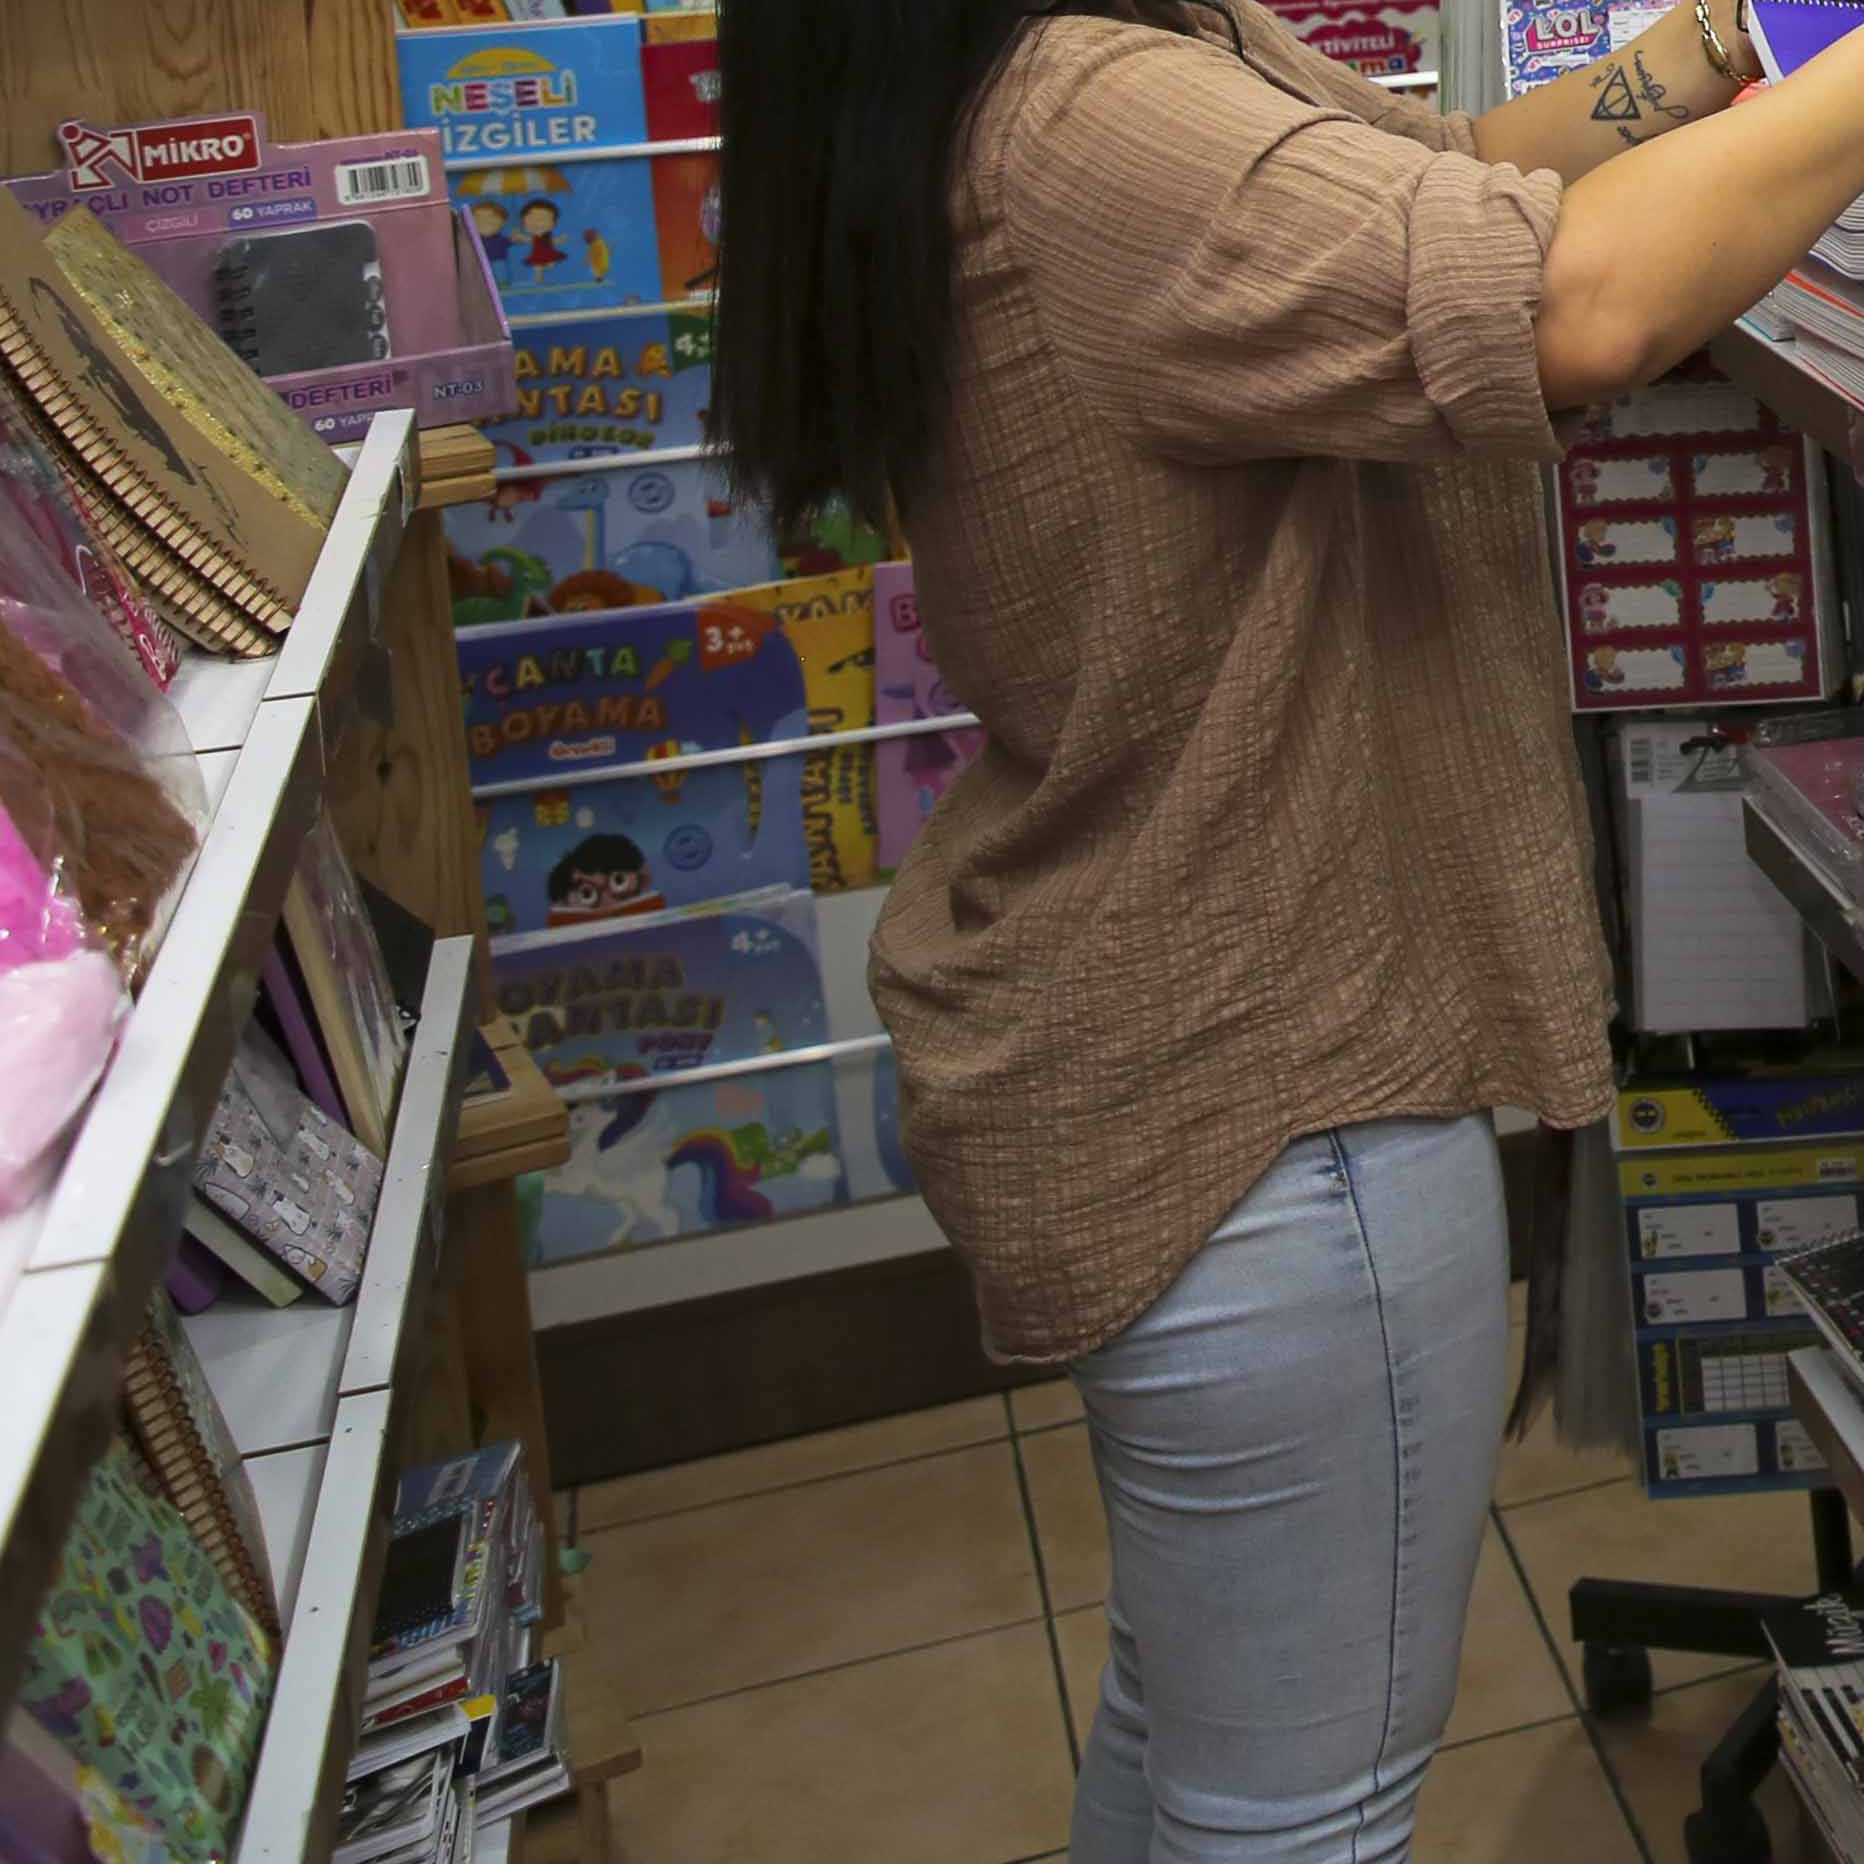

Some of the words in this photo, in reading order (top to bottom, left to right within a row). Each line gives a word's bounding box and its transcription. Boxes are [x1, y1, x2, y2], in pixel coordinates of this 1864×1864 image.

[1533, 7, 1600, 41] LOL
[430, 69, 577, 115] NEŞELİ
[143, 131, 246, 170] MİKRO
[443, 114, 597, 154] İZGİLER
[142, 183, 194, 208] NOT
[207, 165, 312, 200] DEFTERİ
[231, 206, 254, 221] 60
[257, 198, 313, 218] YAPRAK
[290, 378, 392, 411] DEFTERİ
[431, 378, 484, 402] NT-03
[314, 416, 336, 432] 60
[494, 954, 686, 1010] OYAMA
